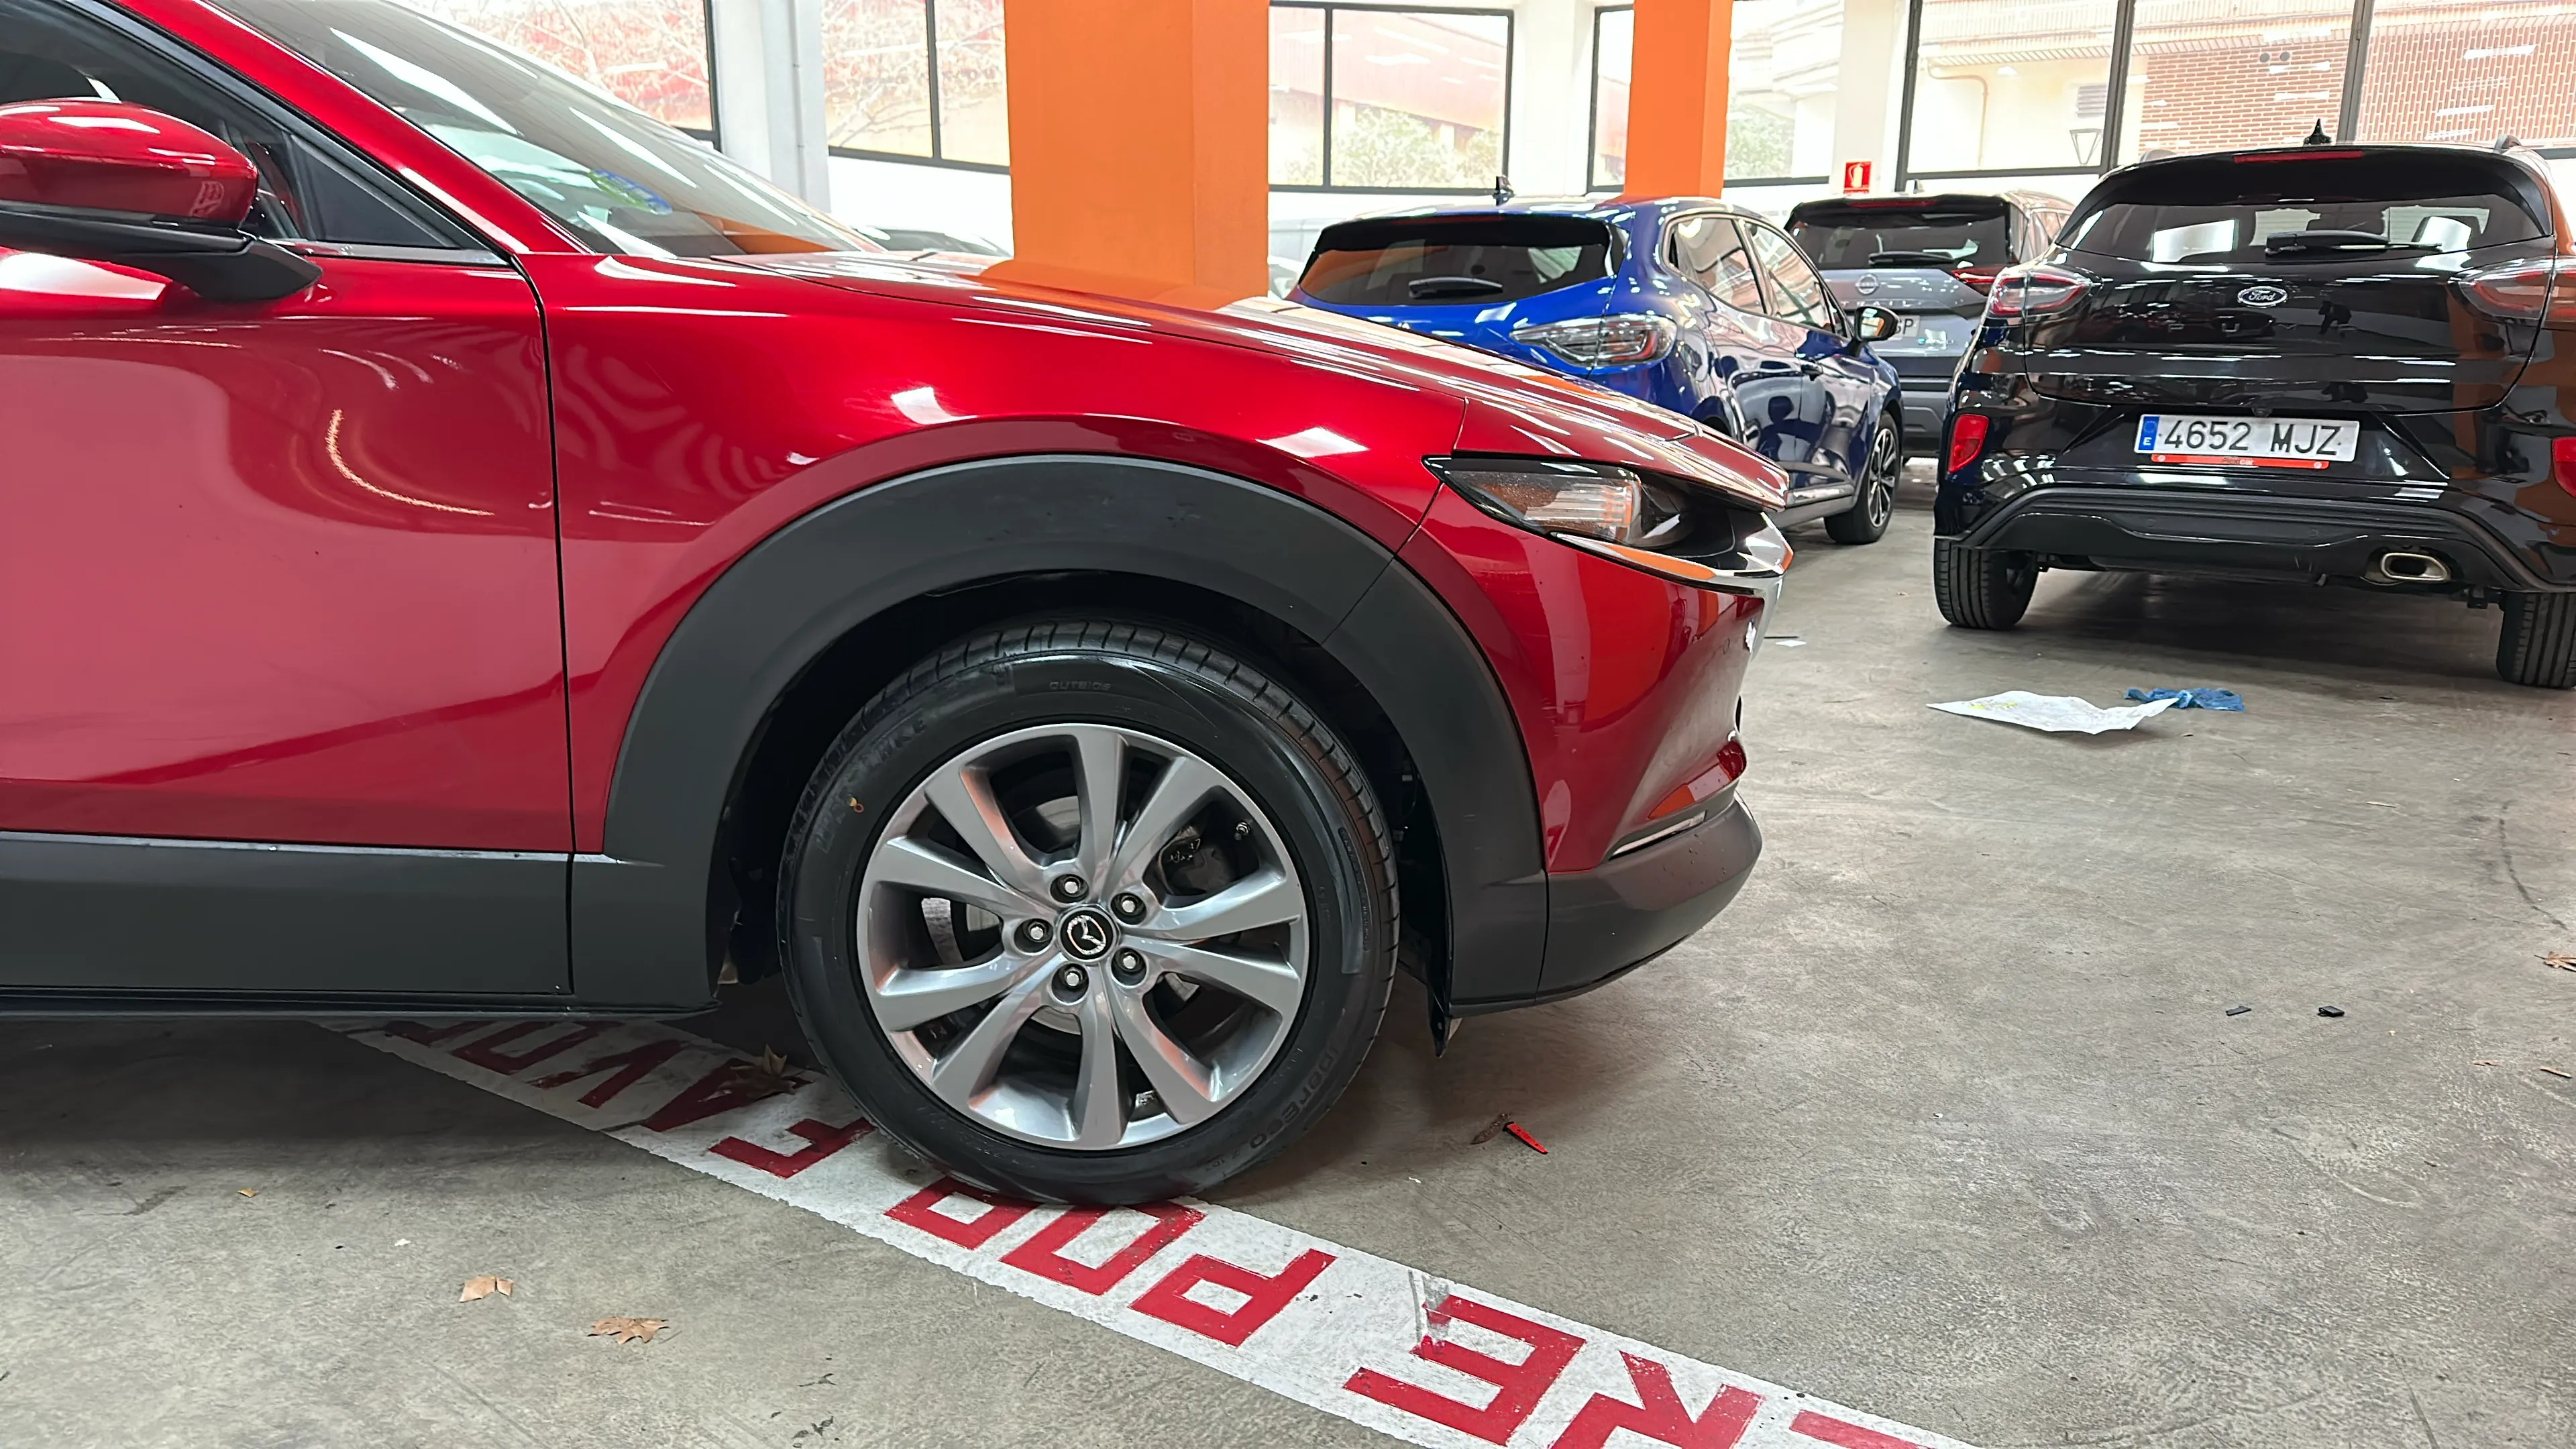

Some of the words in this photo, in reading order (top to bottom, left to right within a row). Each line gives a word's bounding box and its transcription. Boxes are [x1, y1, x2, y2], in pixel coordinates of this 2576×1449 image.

[2248, 290, 2276, 301] Ford
[2143, 437, 2151, 445] E
[2163, 420, 2251, 451] 4652
[2270, 423, 2342, 455] MJZ
